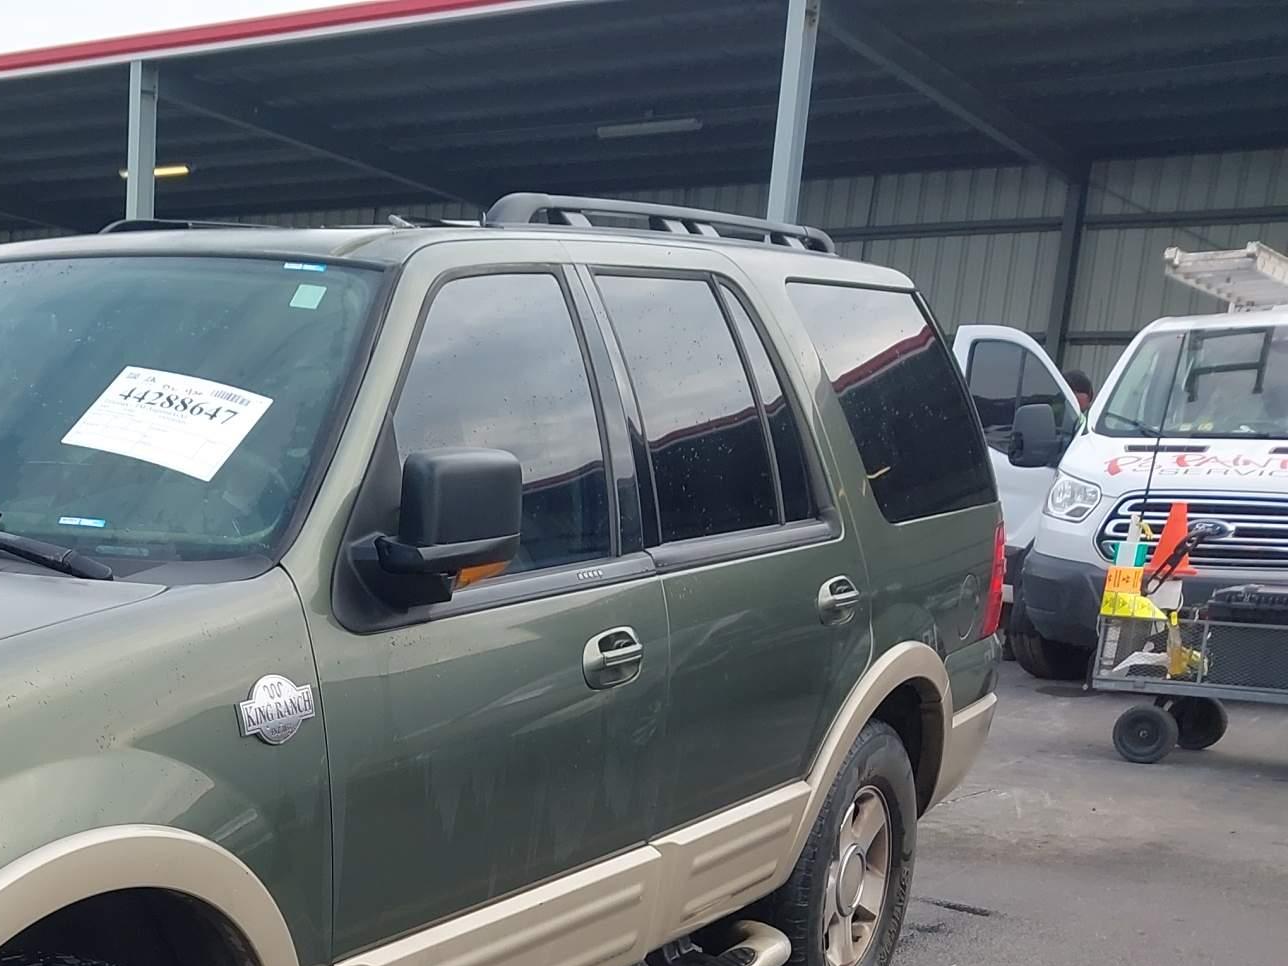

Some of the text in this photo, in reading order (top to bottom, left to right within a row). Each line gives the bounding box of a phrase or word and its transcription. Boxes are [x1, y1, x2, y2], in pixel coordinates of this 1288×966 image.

[120, 387, 238, 424] 44288647
[245, 690, 312, 727] KING RANCH
